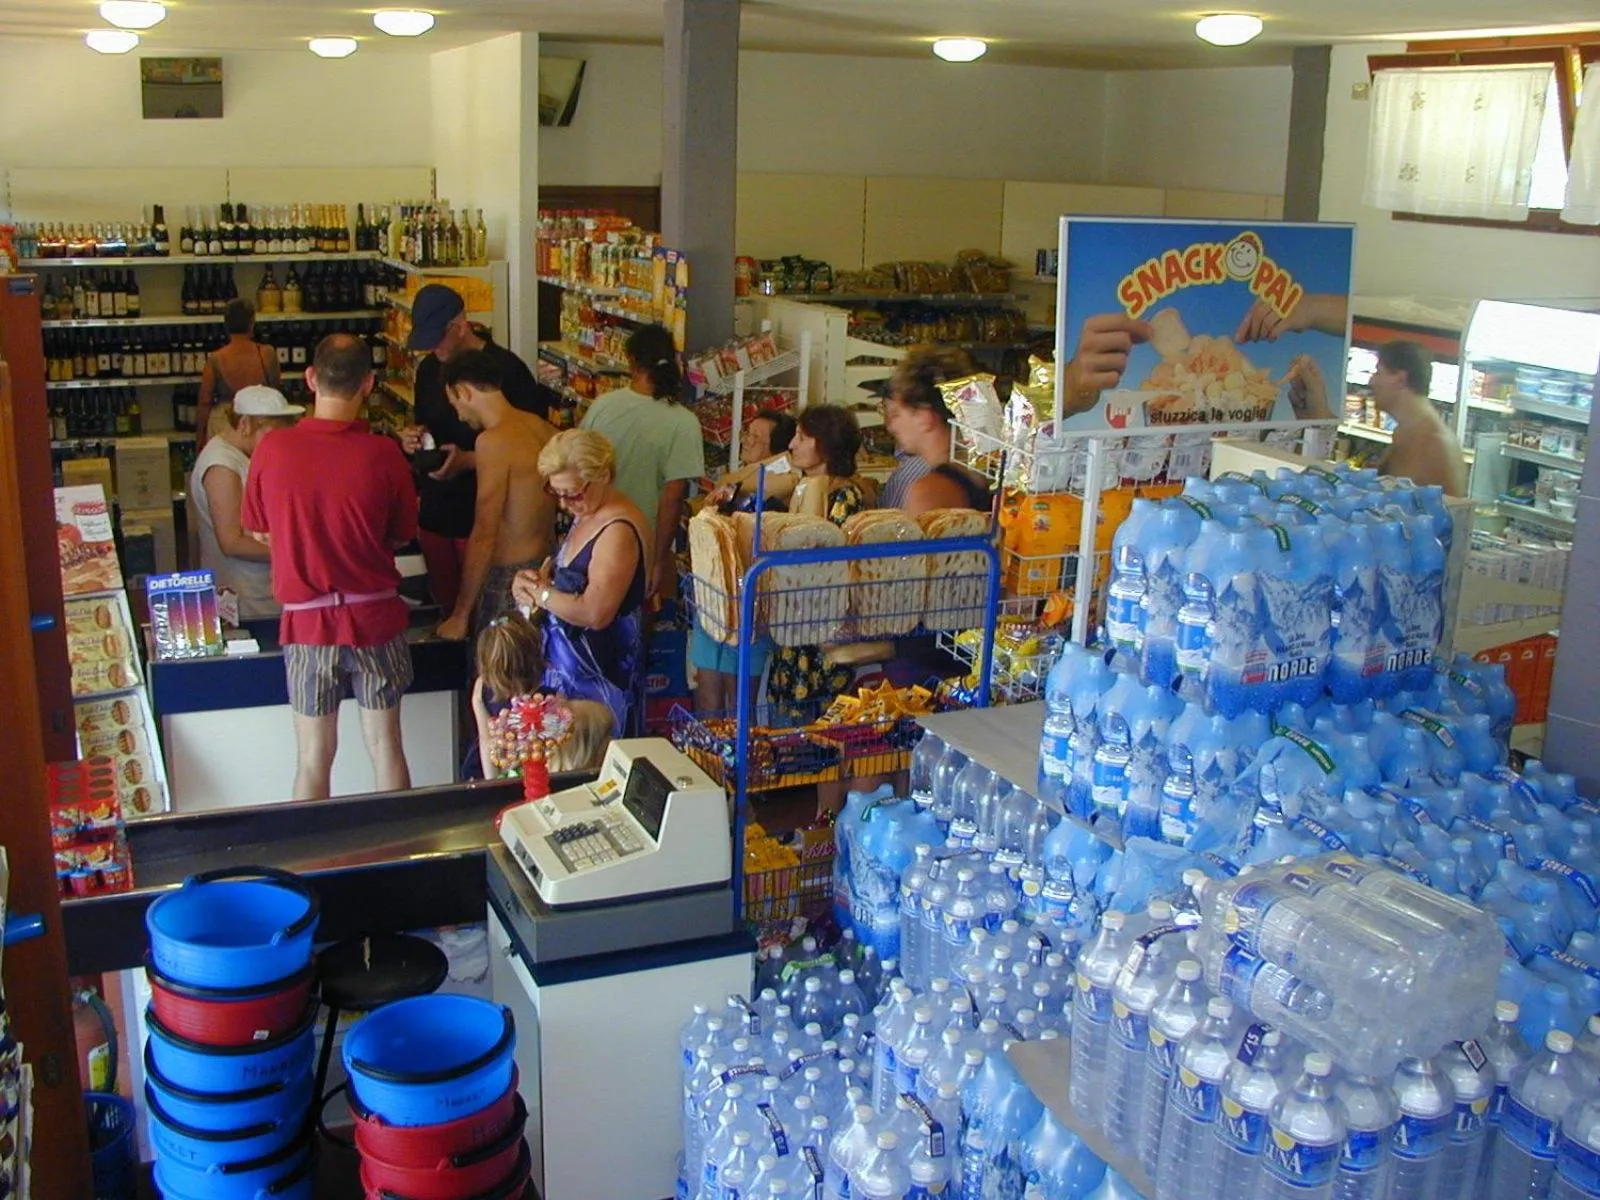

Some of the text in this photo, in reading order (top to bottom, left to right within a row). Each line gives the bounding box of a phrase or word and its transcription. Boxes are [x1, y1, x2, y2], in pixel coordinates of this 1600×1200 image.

[1118, 245, 1302, 318] SNACK PAI
[1211, 406, 1223, 421] la
[150, 574, 212, 590] DIETORELLE
